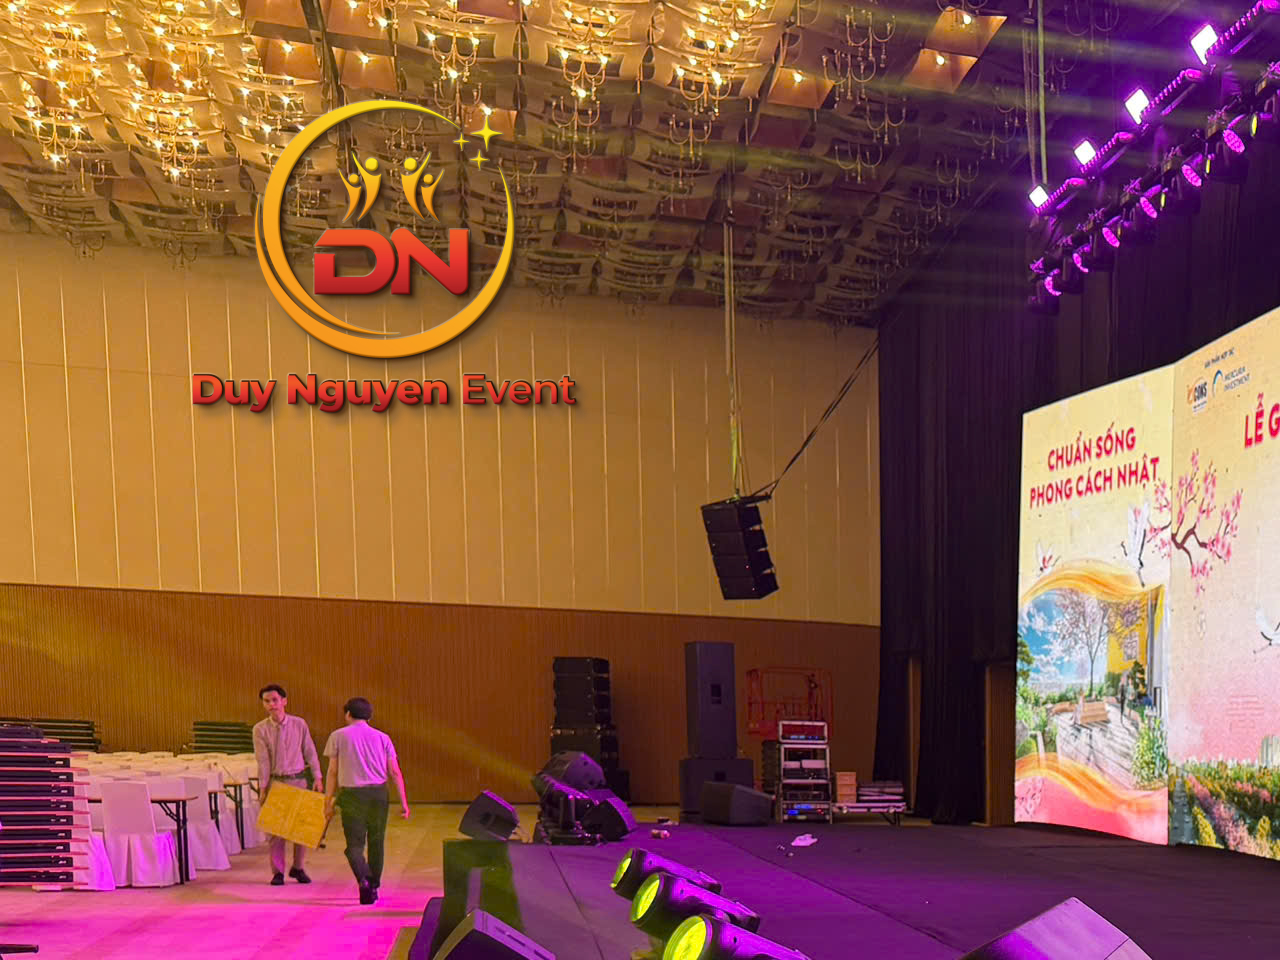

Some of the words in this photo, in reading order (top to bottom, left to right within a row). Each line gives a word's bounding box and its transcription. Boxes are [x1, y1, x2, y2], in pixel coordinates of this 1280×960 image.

[1047, 431, 1092, 472] CHUẨN
[1096, 421, 1136, 459] SỐNG
[1245, 392, 1264, 448] LỄ
[1030, 477, 1073, 509] PHONG
[1075, 467, 1113, 498] CÁCH
[1117, 453, 1160, 489] NHẬT
